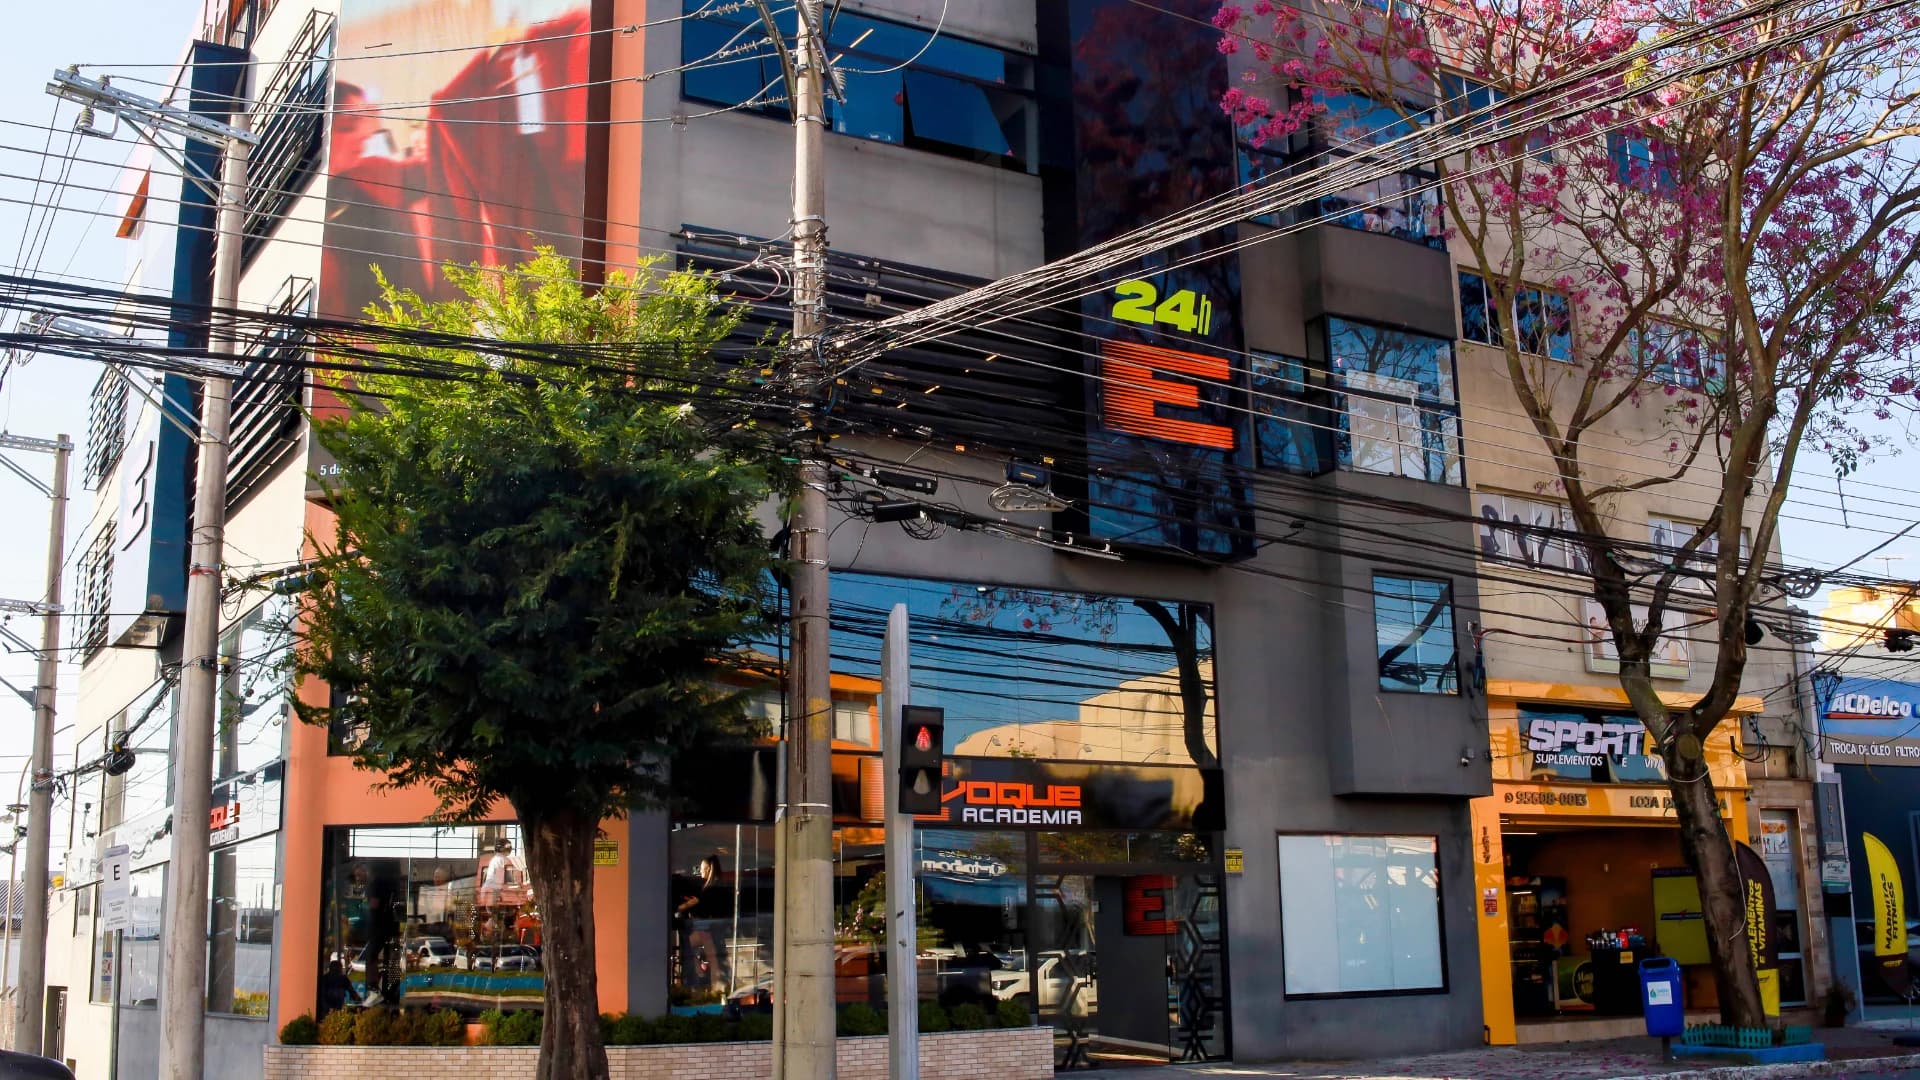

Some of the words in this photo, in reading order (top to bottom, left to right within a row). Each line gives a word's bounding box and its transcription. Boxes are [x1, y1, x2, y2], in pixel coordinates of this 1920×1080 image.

[1111, 279, 1212, 336] 24h
[1102, 339, 1234, 449] E
[1831, 693, 1912, 717] ACDelco
[1535, 753, 1603, 768] SUPLEMENTOS
[1621, 757, 1628, 768] E
[1830, 742, 1857, 755] TROCA
[1870, 741, 1891, 757] ÓLEO
[1630, 795, 1660, 809] LOJA
[962, 807, 1082, 825] ACADEMIA
[113, 864, 121, 881] E
[1755, 882, 1766, 951] VITAMINAS
[1880, 872, 1892, 950] MARMITAS
[1887, 881, 1899, 940] FITNESS
